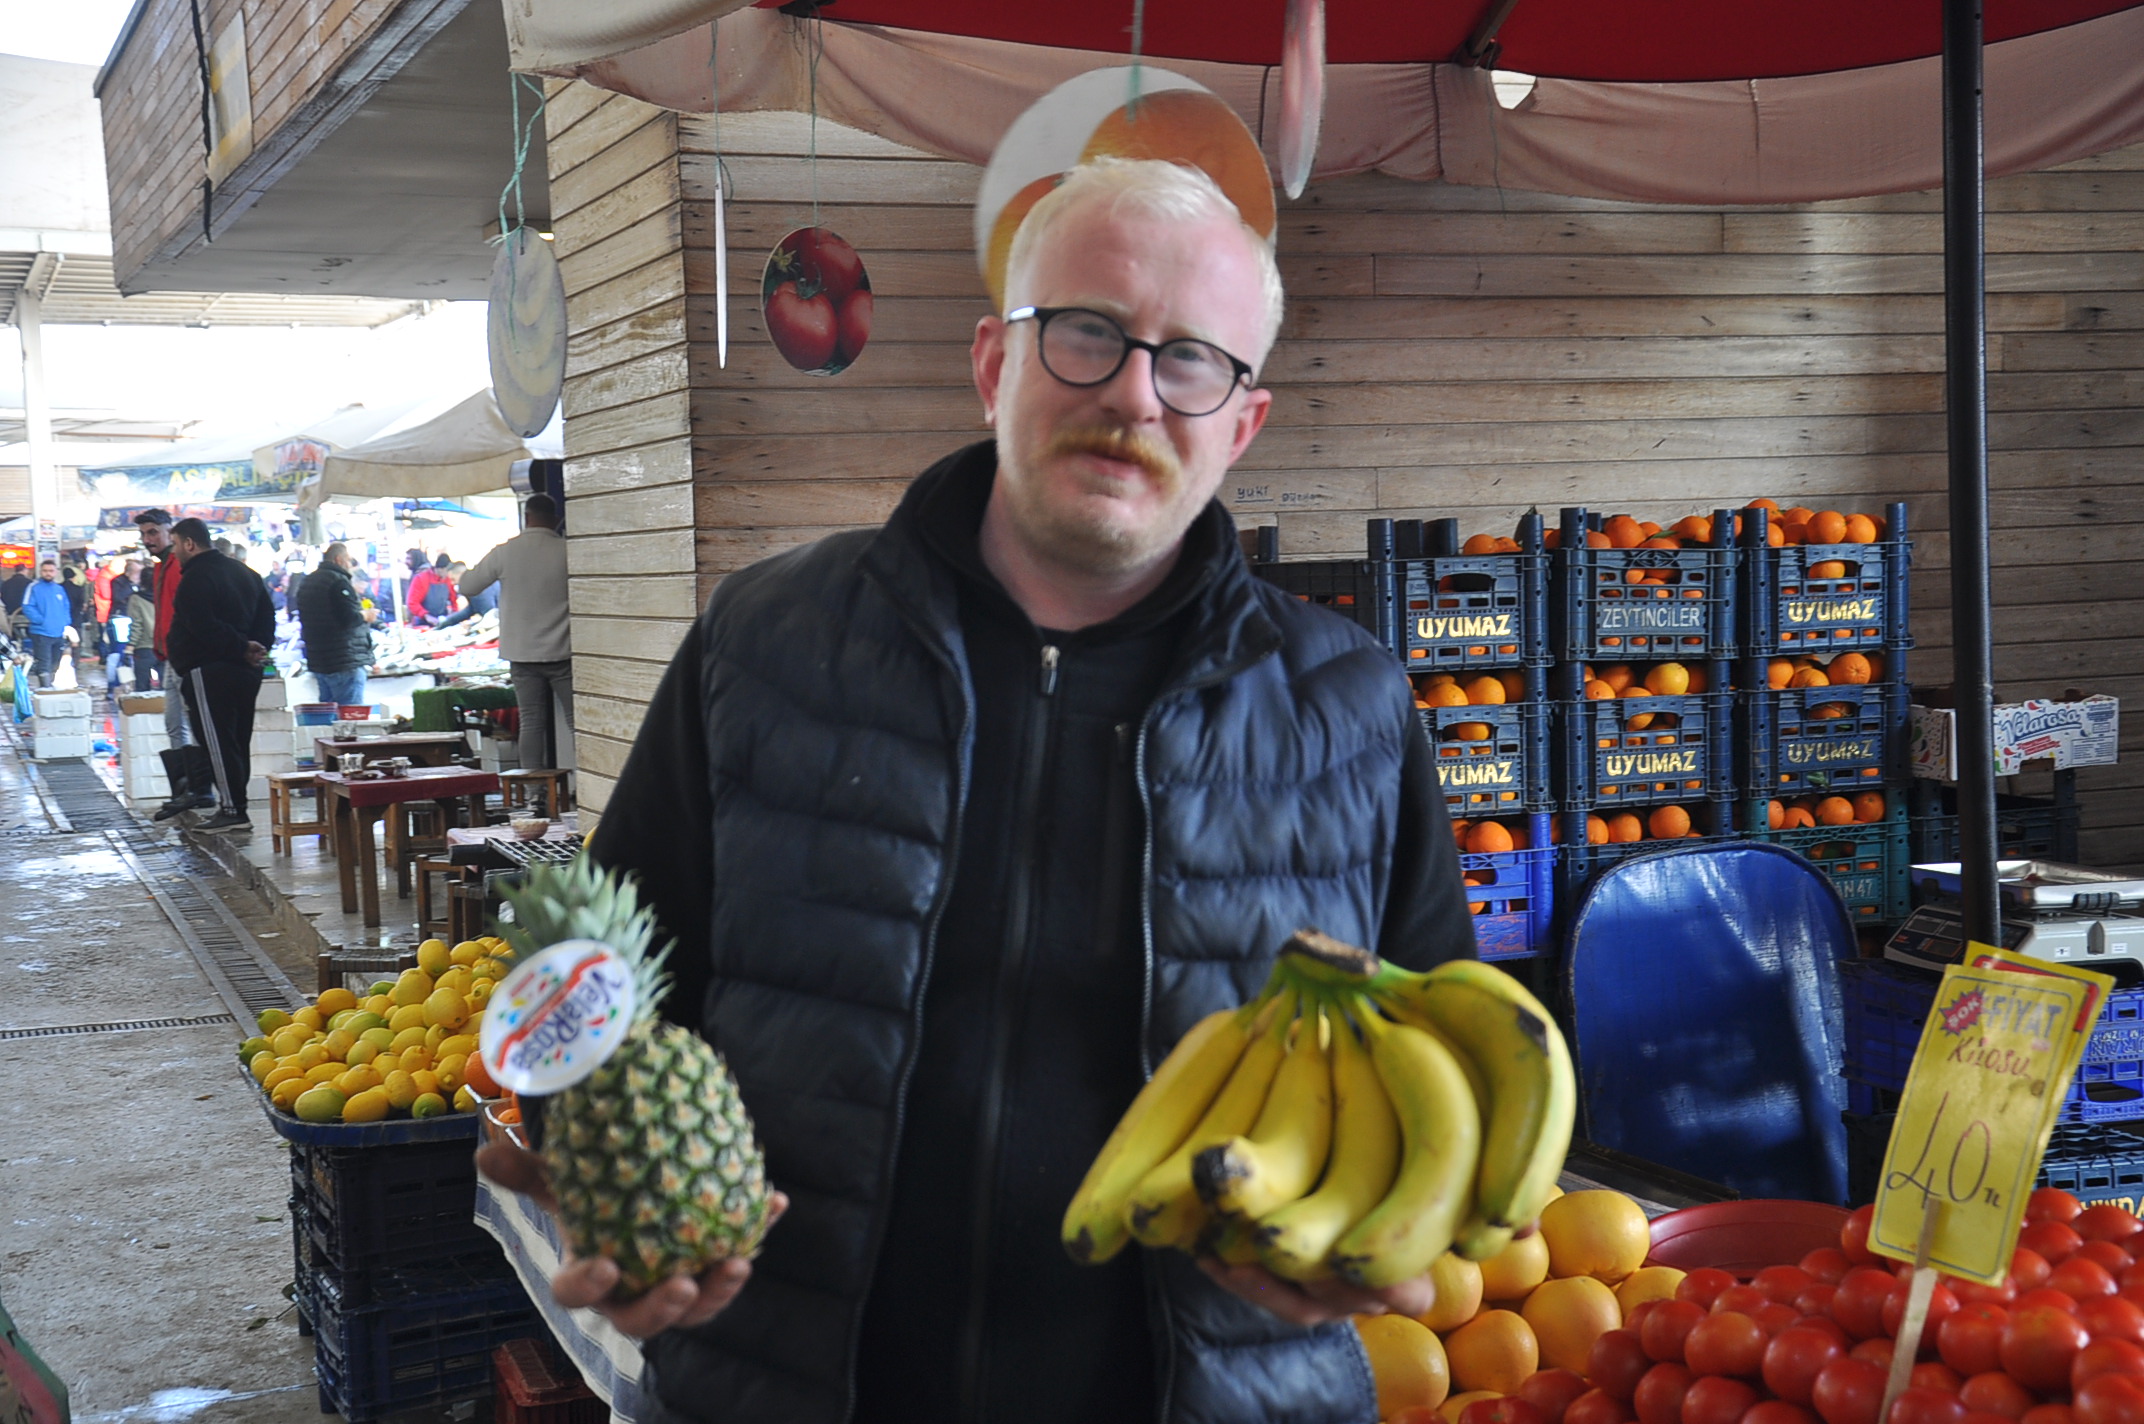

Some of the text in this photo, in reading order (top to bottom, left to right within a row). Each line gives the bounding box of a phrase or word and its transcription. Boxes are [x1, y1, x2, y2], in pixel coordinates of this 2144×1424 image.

[1788, 599, 1875, 622] UYUMAZ
[1417, 614, 1511, 639] UYUMAZ
[1606, 751, 1697, 776] UYUMAZ
[1788, 739, 1875, 763] UYUMAZ
[1436, 761, 1513, 786] YUMAZ
